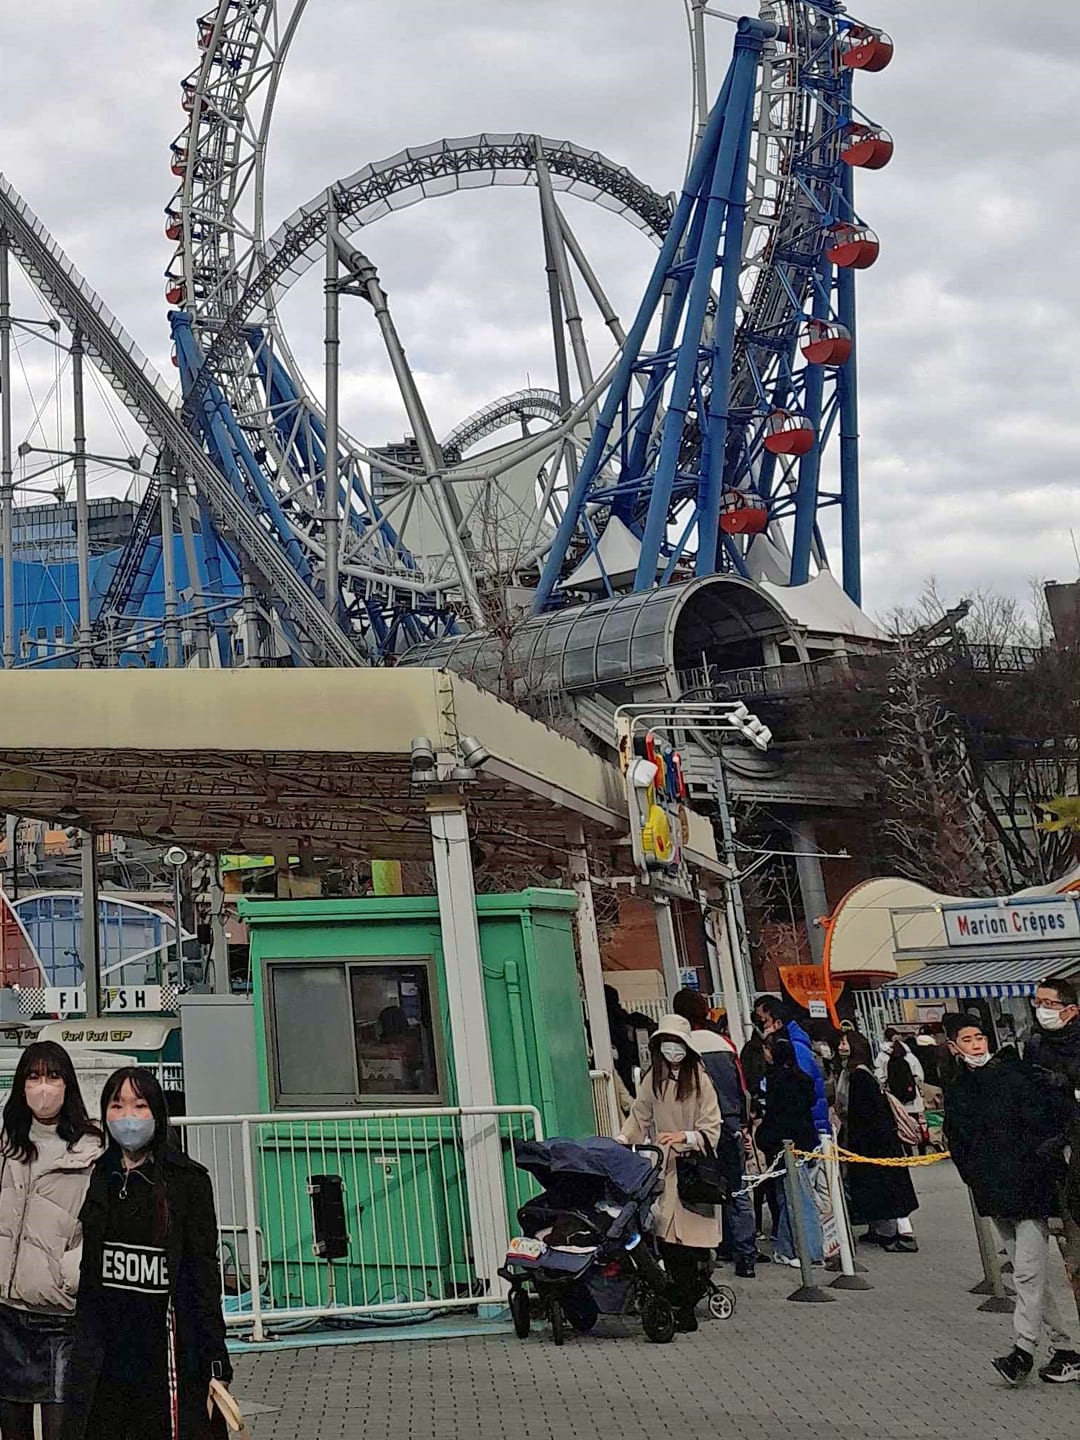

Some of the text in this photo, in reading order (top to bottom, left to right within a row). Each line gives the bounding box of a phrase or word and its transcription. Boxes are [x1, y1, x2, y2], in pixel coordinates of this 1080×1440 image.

[957, 911, 1065, 936] Marion Crêpes
[59, 990, 146, 1010] FIISH
[110, 1031, 133, 1042] GP
[102, 1249, 169, 1285] ESOME
